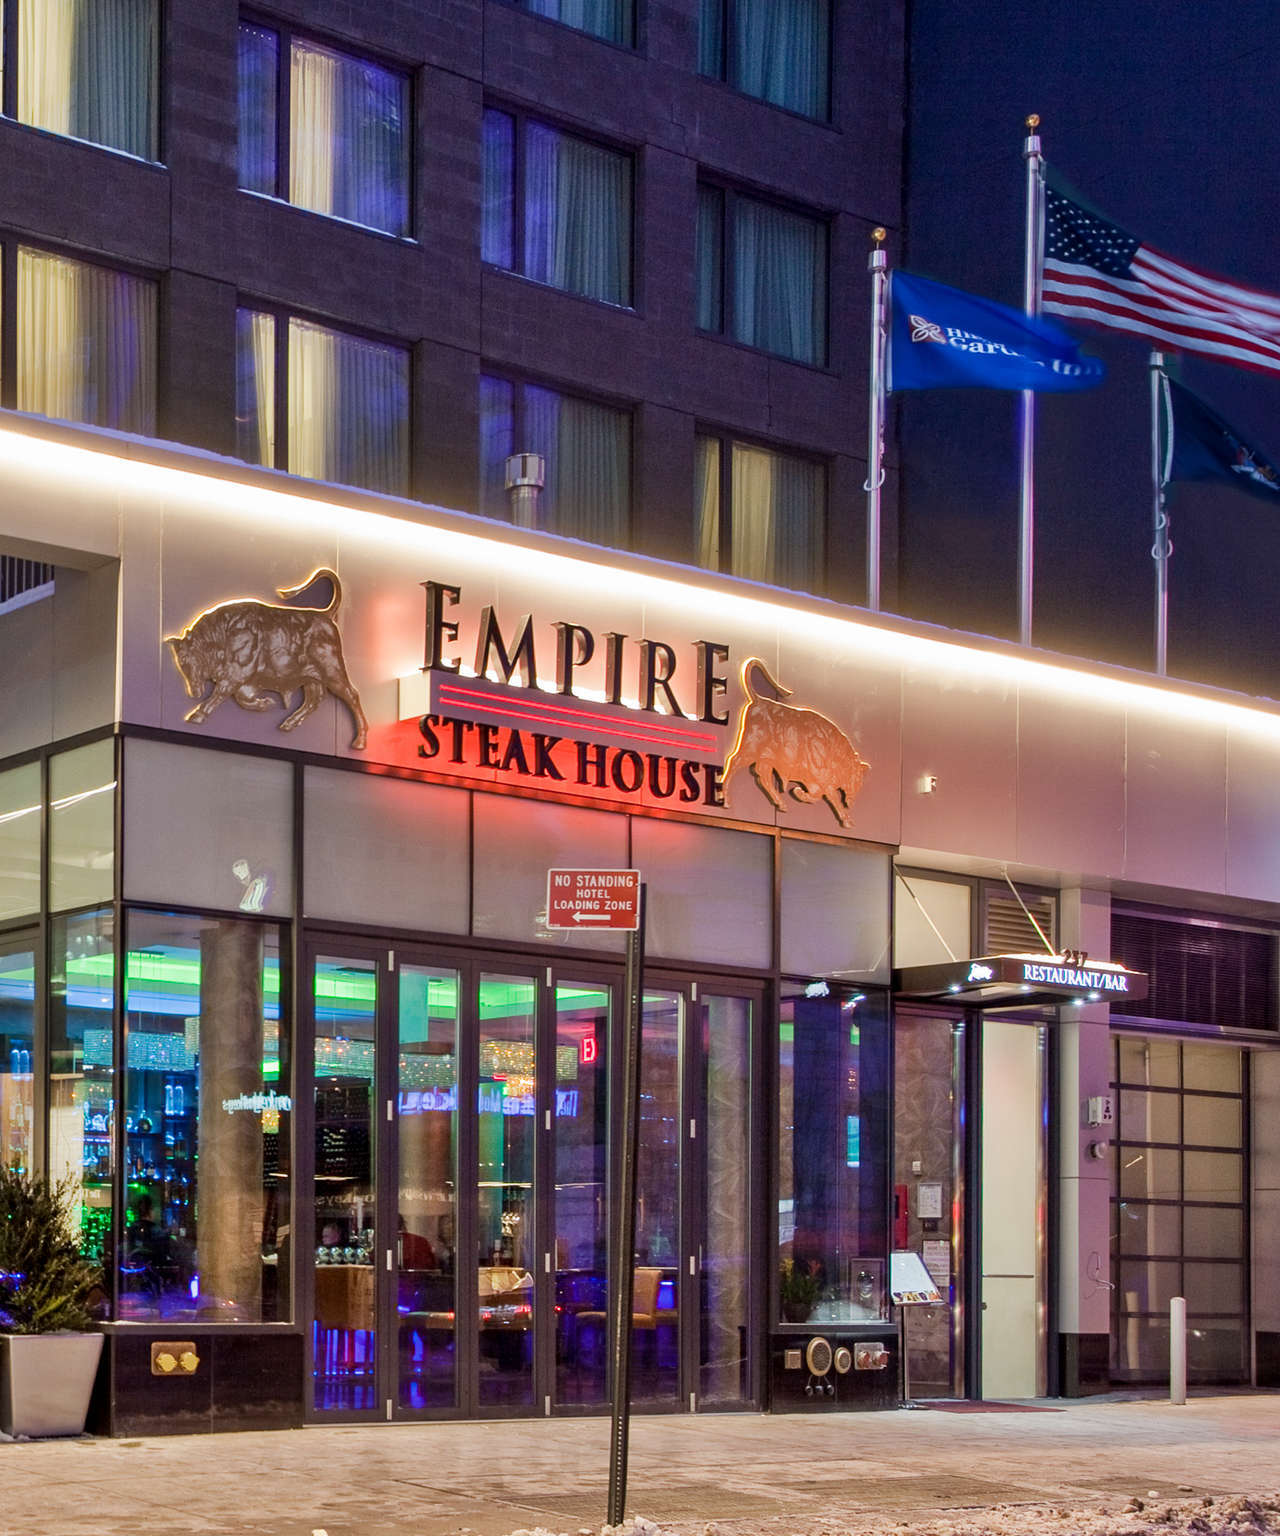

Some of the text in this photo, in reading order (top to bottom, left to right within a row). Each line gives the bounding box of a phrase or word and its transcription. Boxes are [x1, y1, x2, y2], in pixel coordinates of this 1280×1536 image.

[419, 579, 730, 726] EMPIRE
[554, 875, 634, 888] NO STANDING
[576, 889, 611, 899] HOTEL
[554, 900, 633, 911] LOADING ZONE
[1023, 963, 1129, 992] RESTAURANT/BAR
